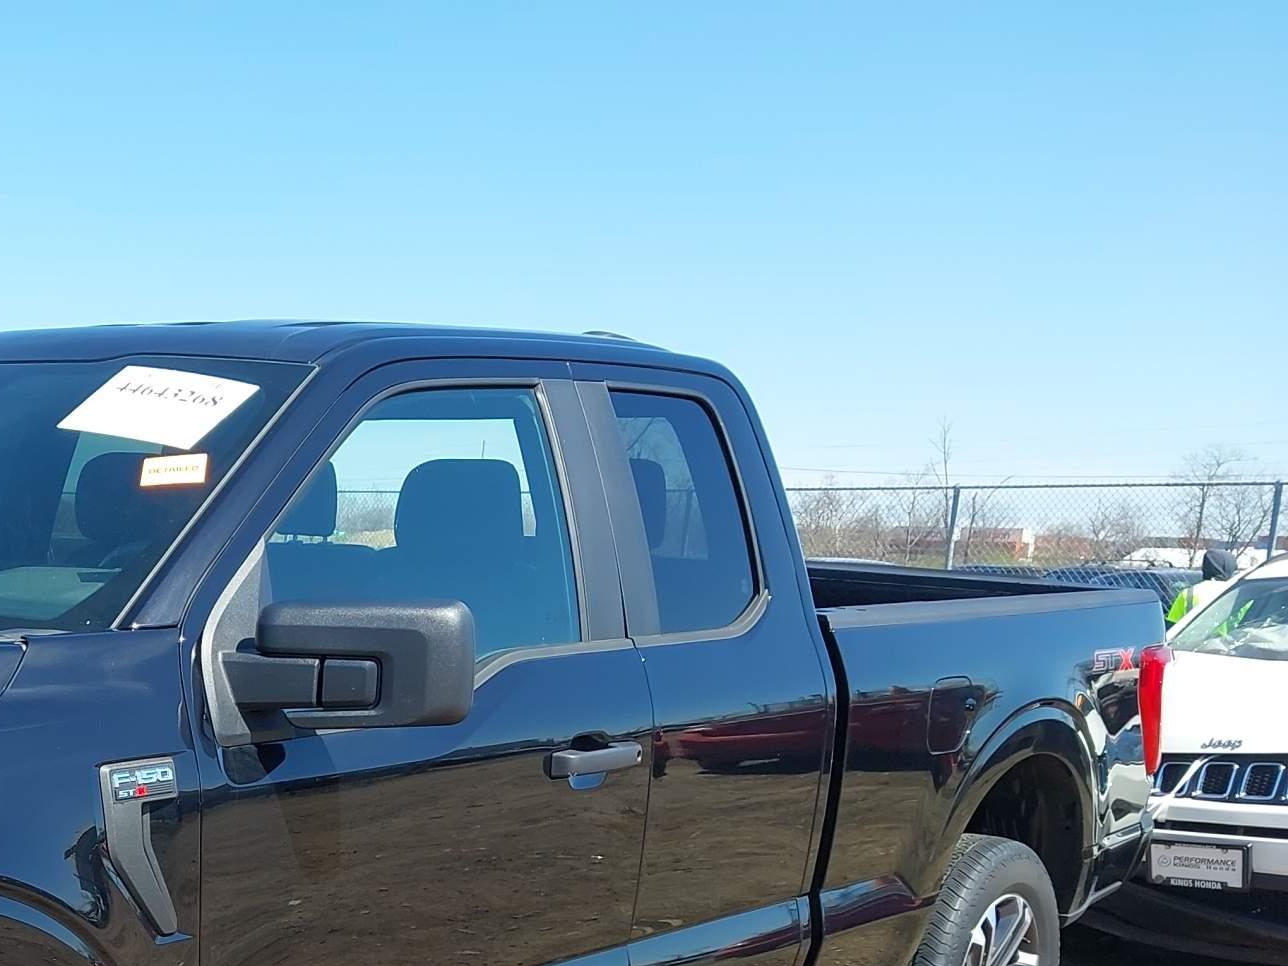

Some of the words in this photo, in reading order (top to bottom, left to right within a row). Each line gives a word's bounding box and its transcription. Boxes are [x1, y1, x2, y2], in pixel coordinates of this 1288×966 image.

[116, 382, 224, 407] 44643268
[1092, 648, 1134, 673] STX
[1200, 737, 1243, 751] Jeep
[113, 768, 174, 788] F-150
[1173, 855, 1237, 868] PERFORMANCE
[1171, 878, 1192, 887] KINGS
[1194, 879, 1223, 890] HONDA
